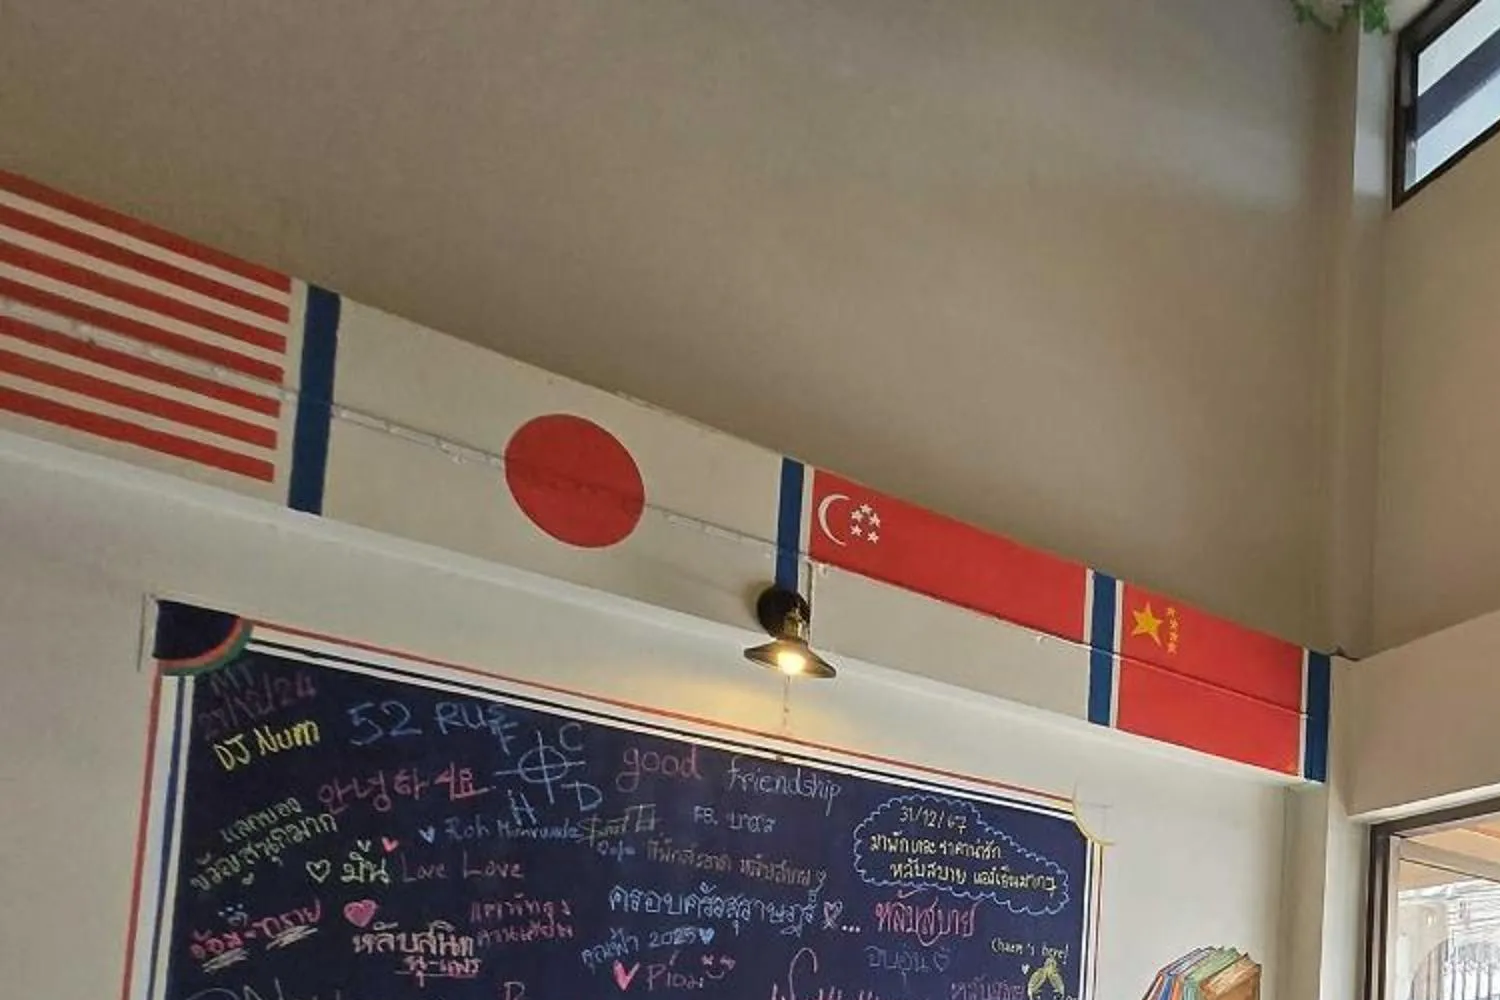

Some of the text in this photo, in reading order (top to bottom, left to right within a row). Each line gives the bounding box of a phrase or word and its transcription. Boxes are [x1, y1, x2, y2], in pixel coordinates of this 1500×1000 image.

[347, 700, 423, 746] 52
[213, 732, 251, 771] DJ
[615, 743, 842, 818] good friendship
